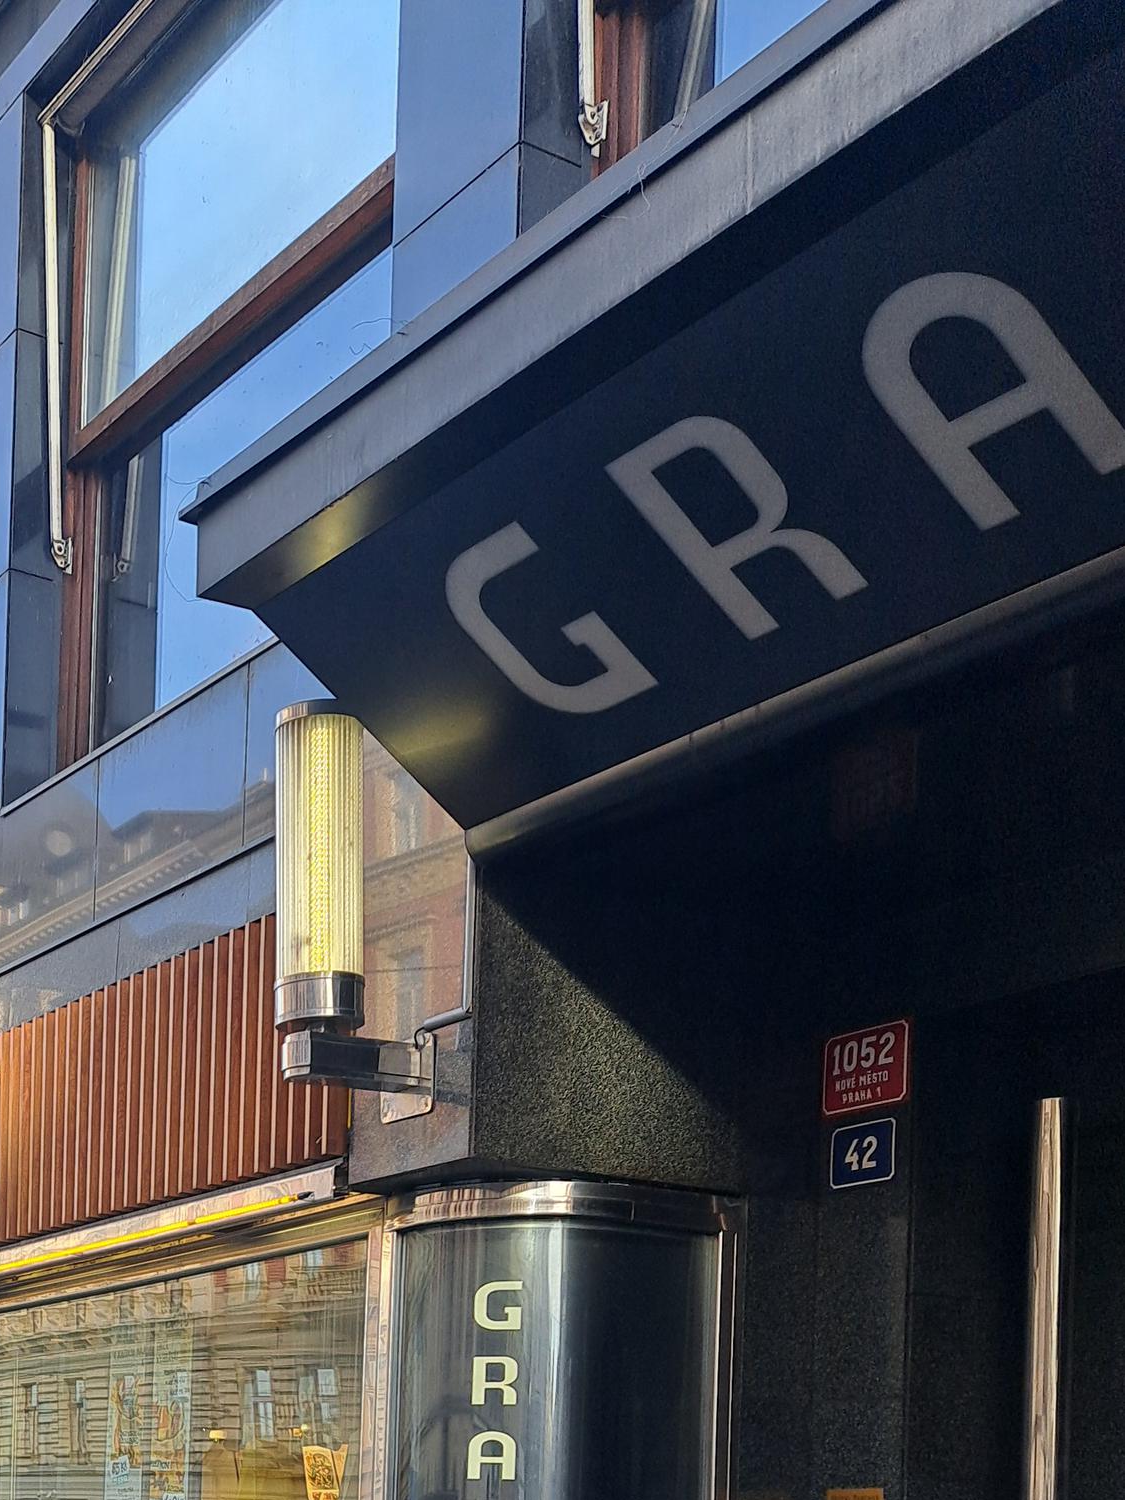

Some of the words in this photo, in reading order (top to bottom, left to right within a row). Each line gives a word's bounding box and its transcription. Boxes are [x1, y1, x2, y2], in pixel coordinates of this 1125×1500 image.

[444, 271, 1125, 714] GRA
[832, 1031, 896, 1076] 1052
[835, 1074, 857, 1092] NOVÉ
[859, 1070, 889, 1086] MĚSTO
[842, 1089, 872, 1104] PRAHA
[876, 1086, 882, 1098] 1
[844, 1135, 878, 1171] 42
